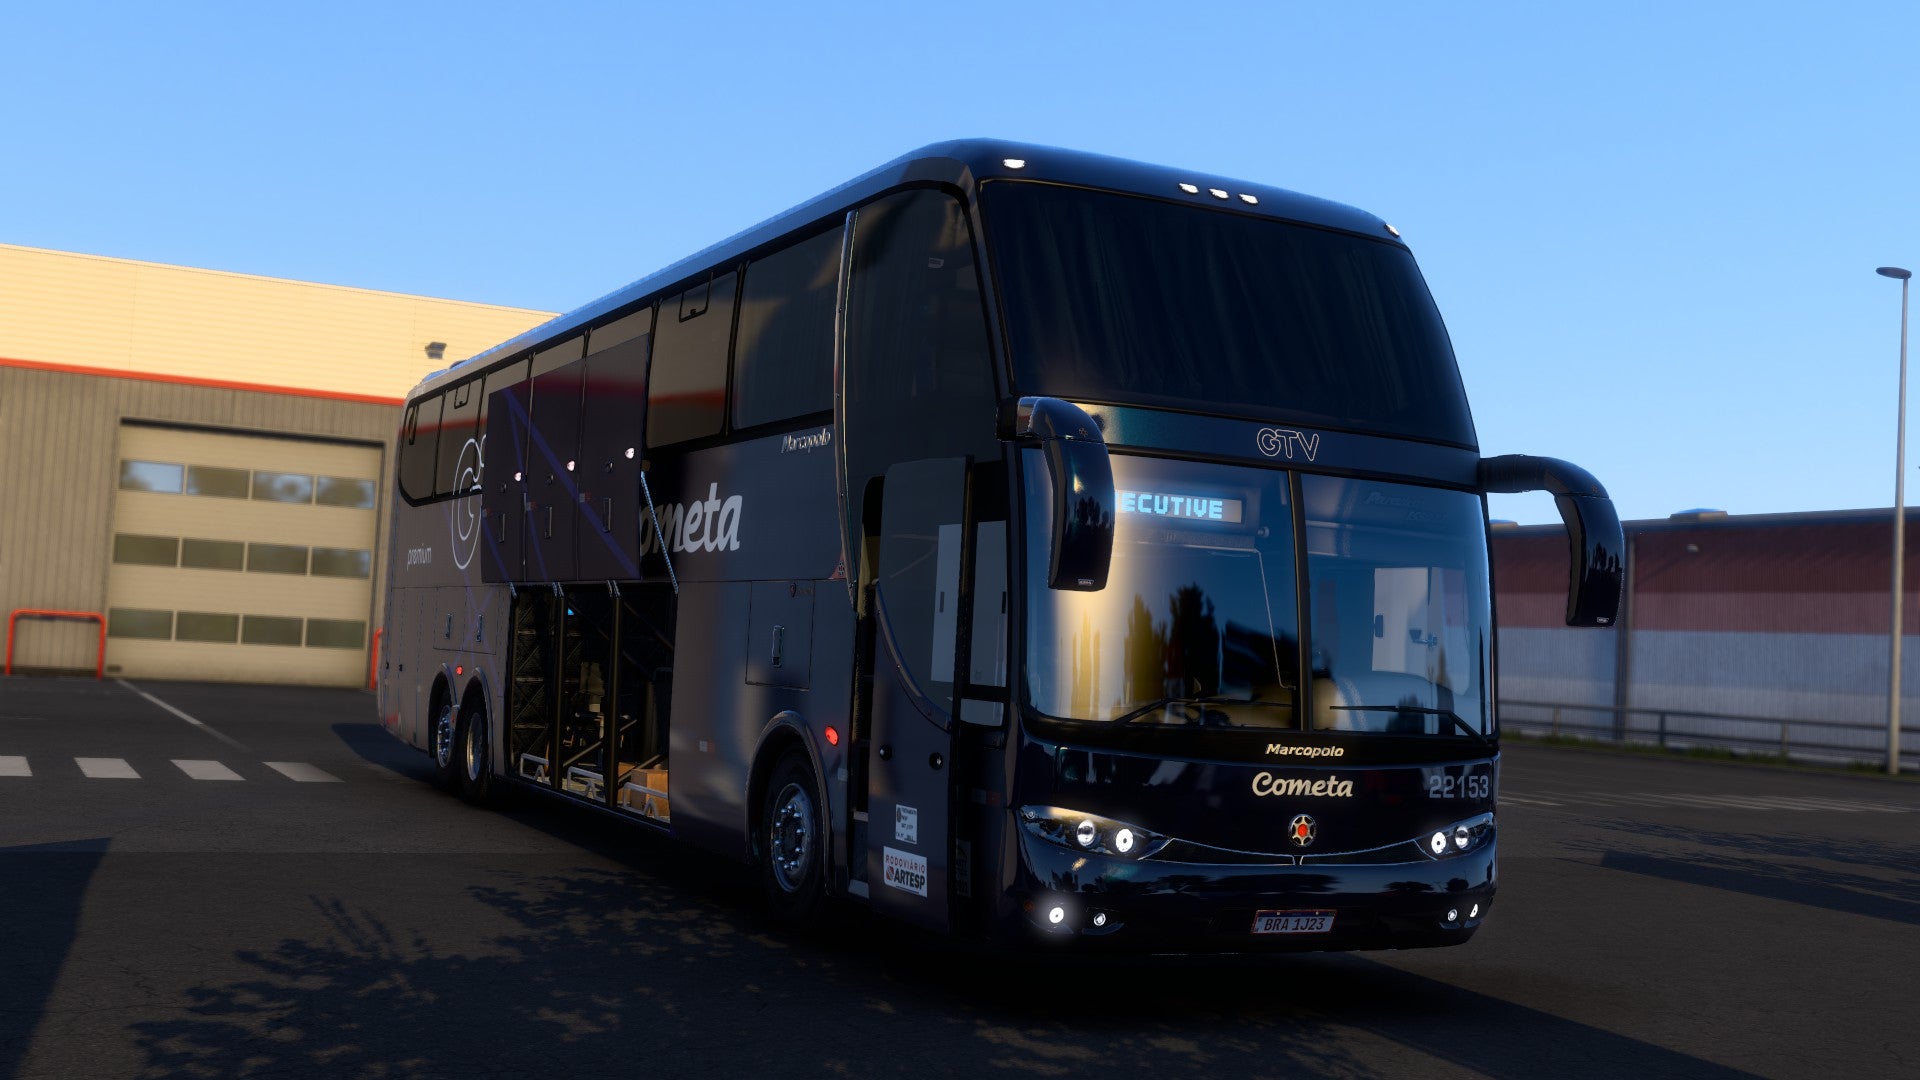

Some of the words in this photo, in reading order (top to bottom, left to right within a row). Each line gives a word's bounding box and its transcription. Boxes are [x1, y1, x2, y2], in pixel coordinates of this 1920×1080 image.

[1256, 427, 1320, 462] GTV
[1115, 489, 1223, 519] ECUTIVE
[640, 482, 743, 557] ometa
[1265, 743, 1345, 759] Marcopolo
[1251, 771, 1354, 797] Cometa
[1429, 774, 1489, 799] 22153
[894, 868, 925, 890] ARTESP
[1264, 918, 1290, 931] BRA
[1291, 917, 1326, 931] 1J23
